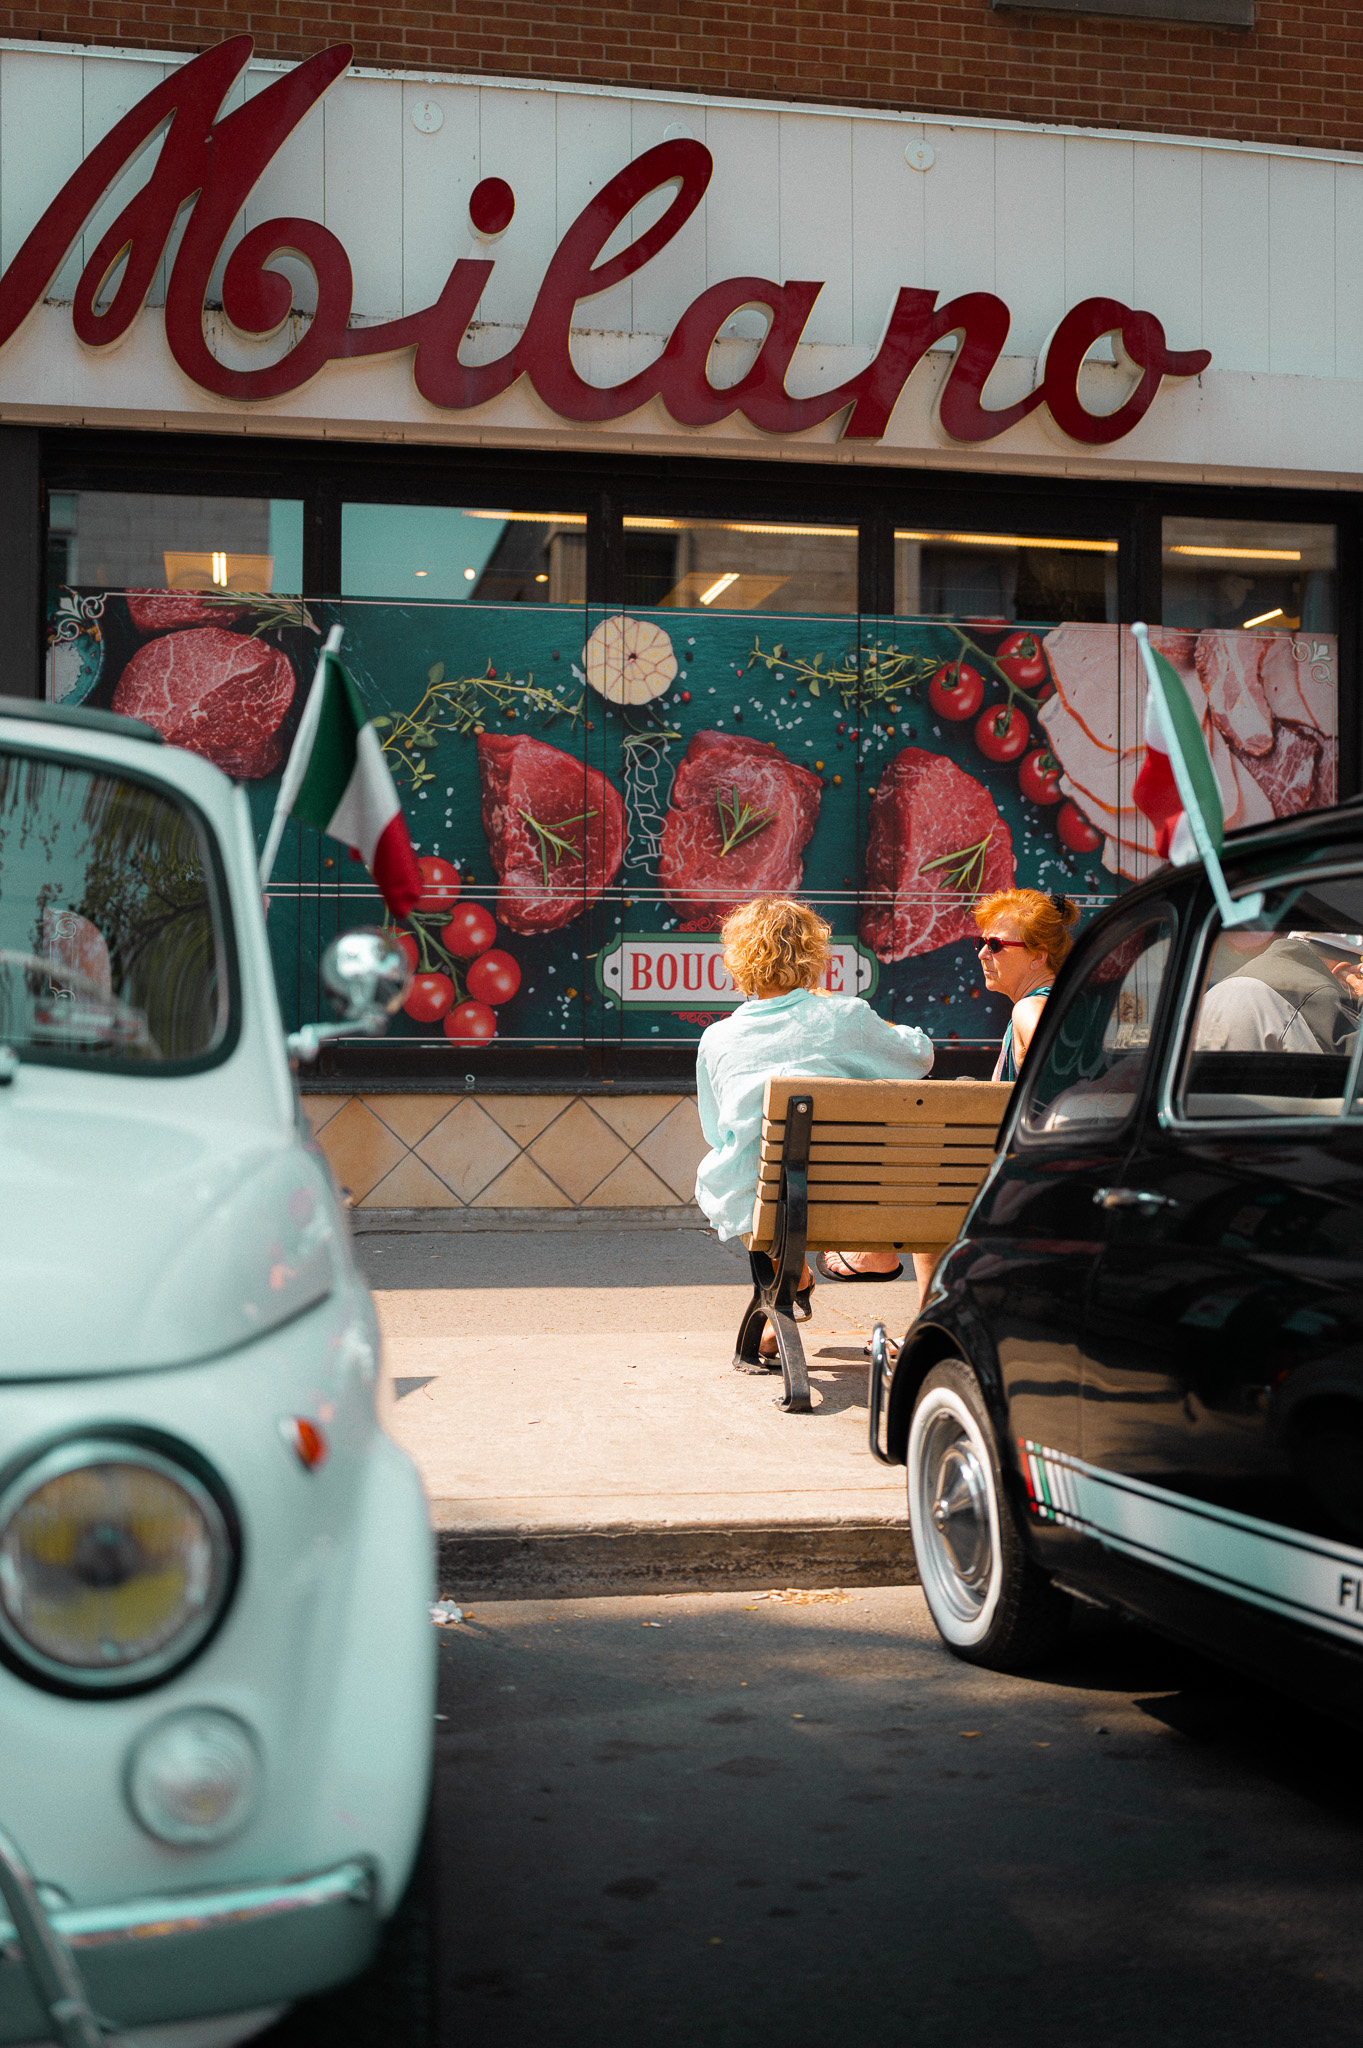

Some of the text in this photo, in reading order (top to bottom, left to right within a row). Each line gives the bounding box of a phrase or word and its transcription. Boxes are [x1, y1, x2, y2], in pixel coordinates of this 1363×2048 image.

[0, 34, 1212, 445] Milano
[630, 952, 844, 992] BOUCE
[1339, 1574, 1363, 1612] FI
